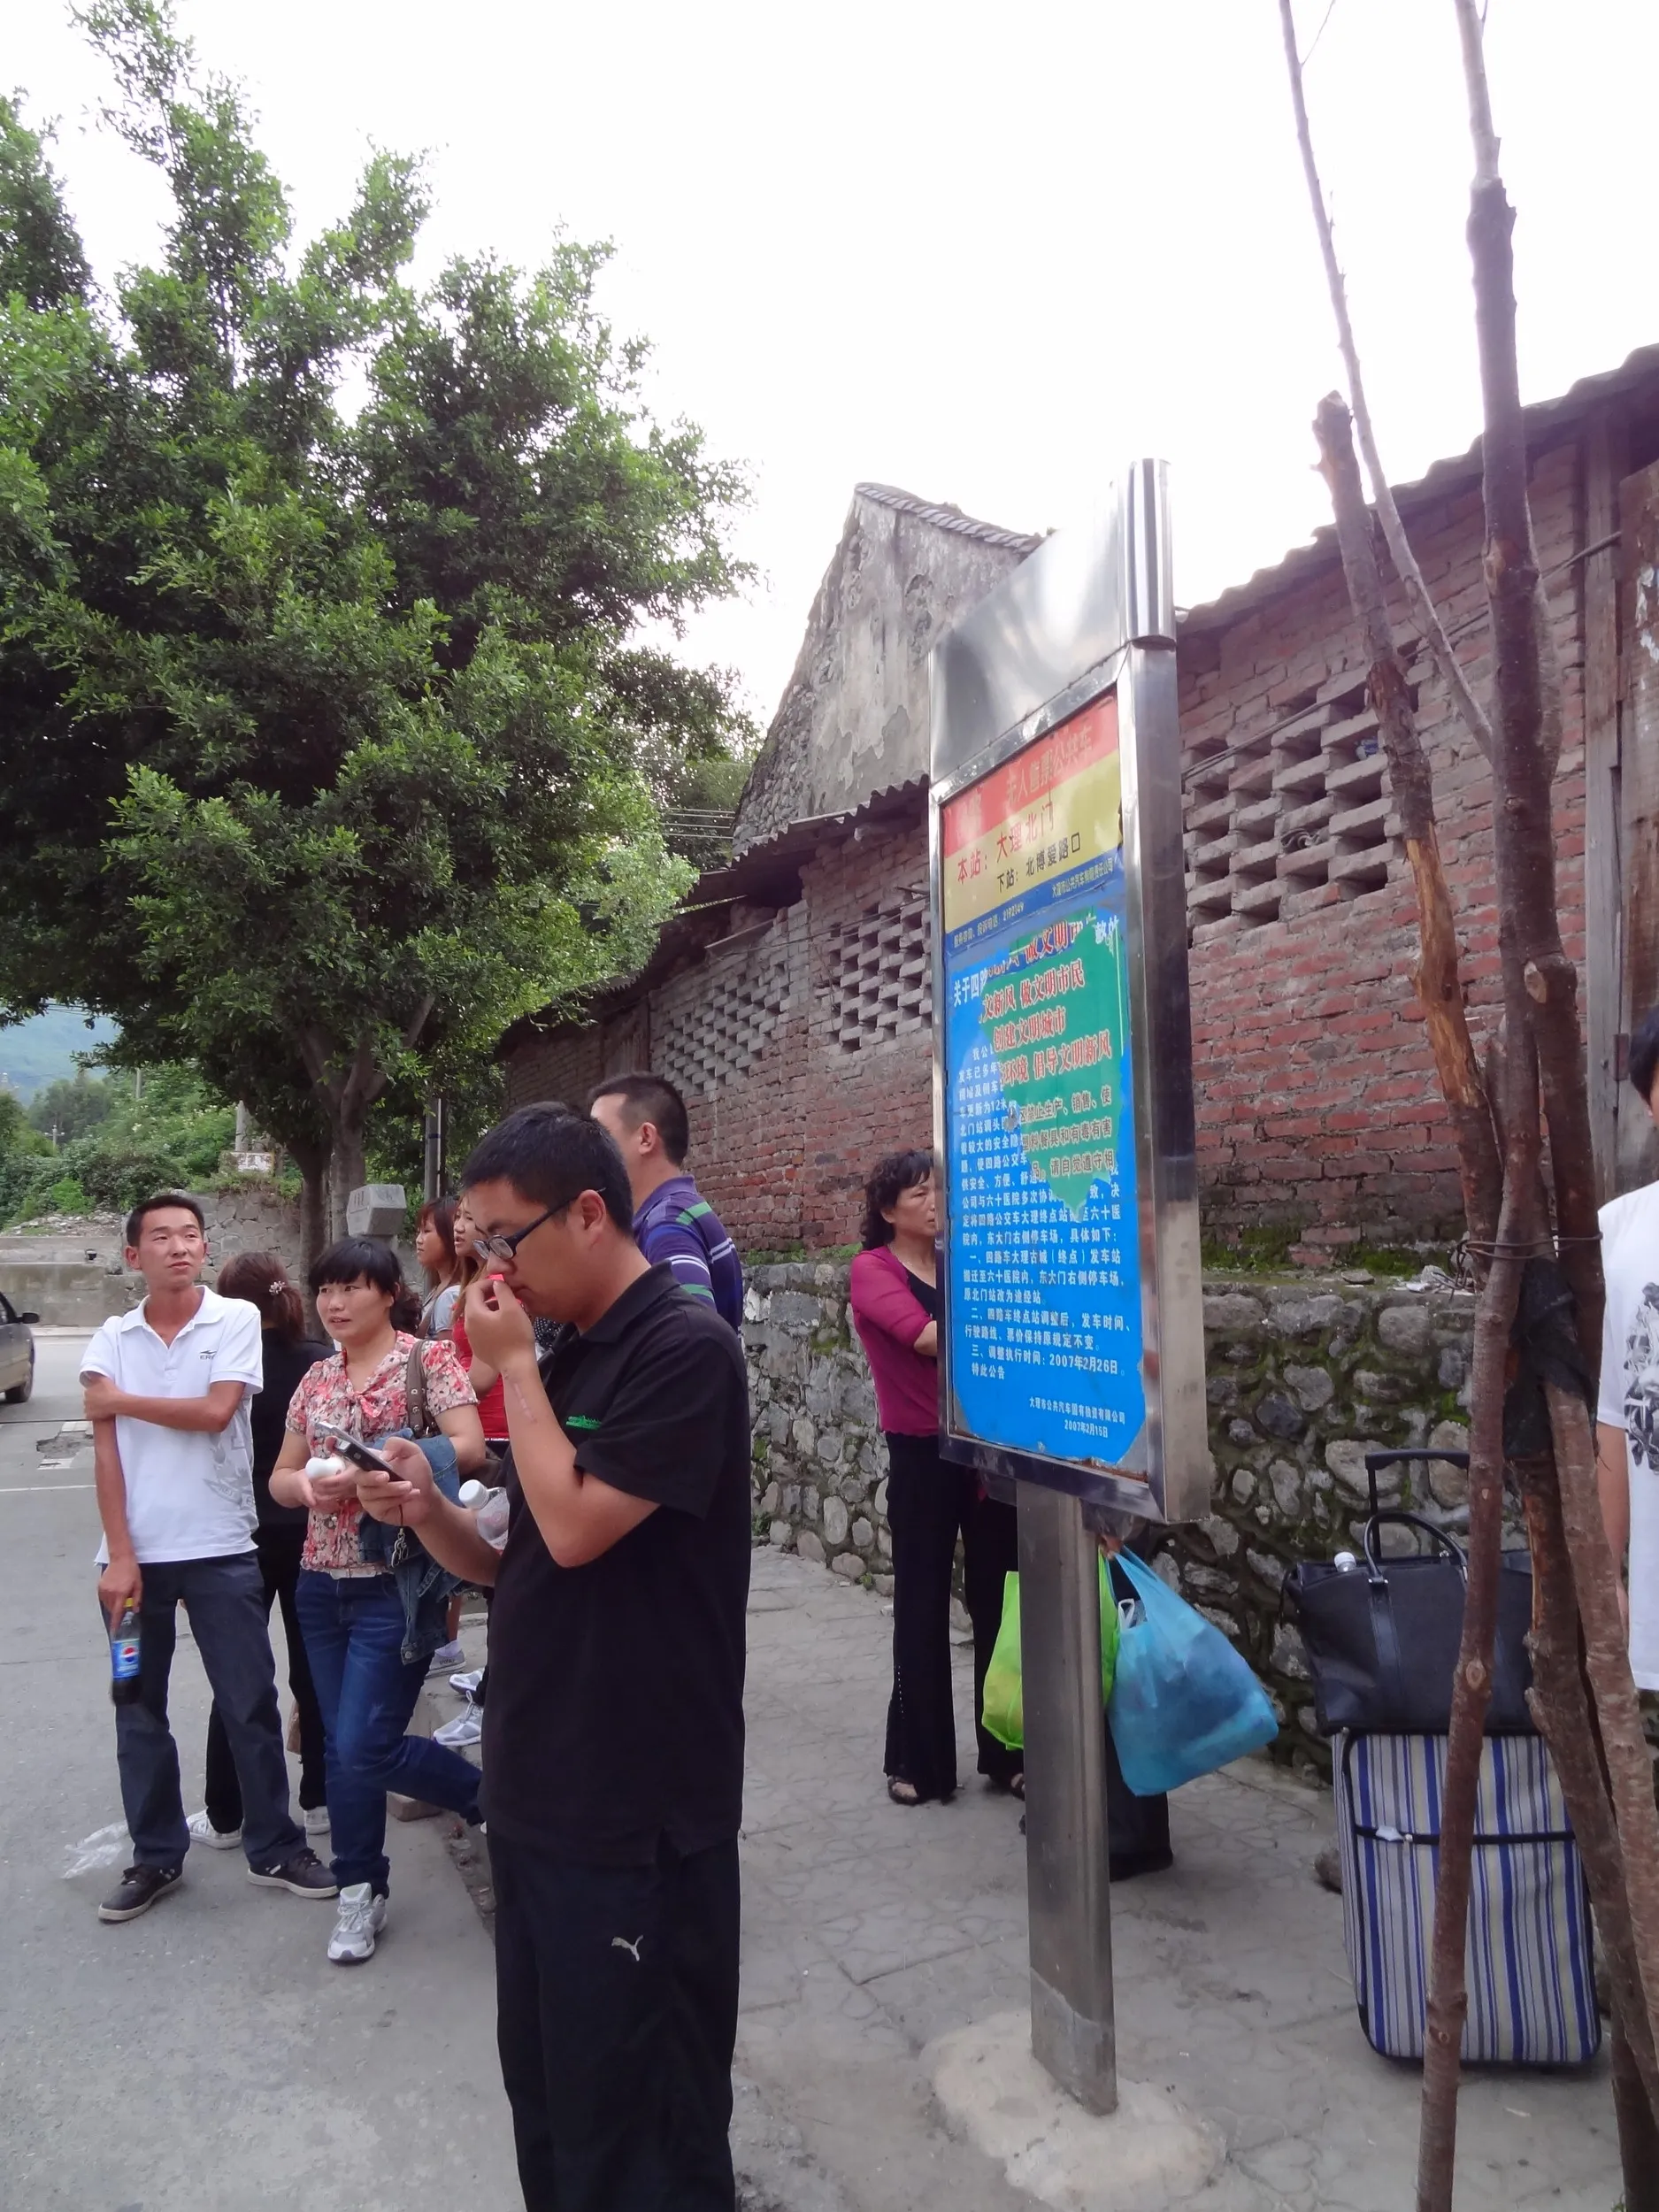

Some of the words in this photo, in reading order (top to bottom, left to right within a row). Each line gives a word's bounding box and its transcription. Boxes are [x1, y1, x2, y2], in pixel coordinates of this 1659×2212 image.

[1020, 957, 1086, 1010] 做文明市民
[993, 1005, 1066, 1053] 创建文明城市
[1033, 1029, 1112, 1079] 倡导文明新风
[972, 1363, 1005, 1379] 特此公告
[1064, 1419, 1108, 1438] 2007年2月15日
